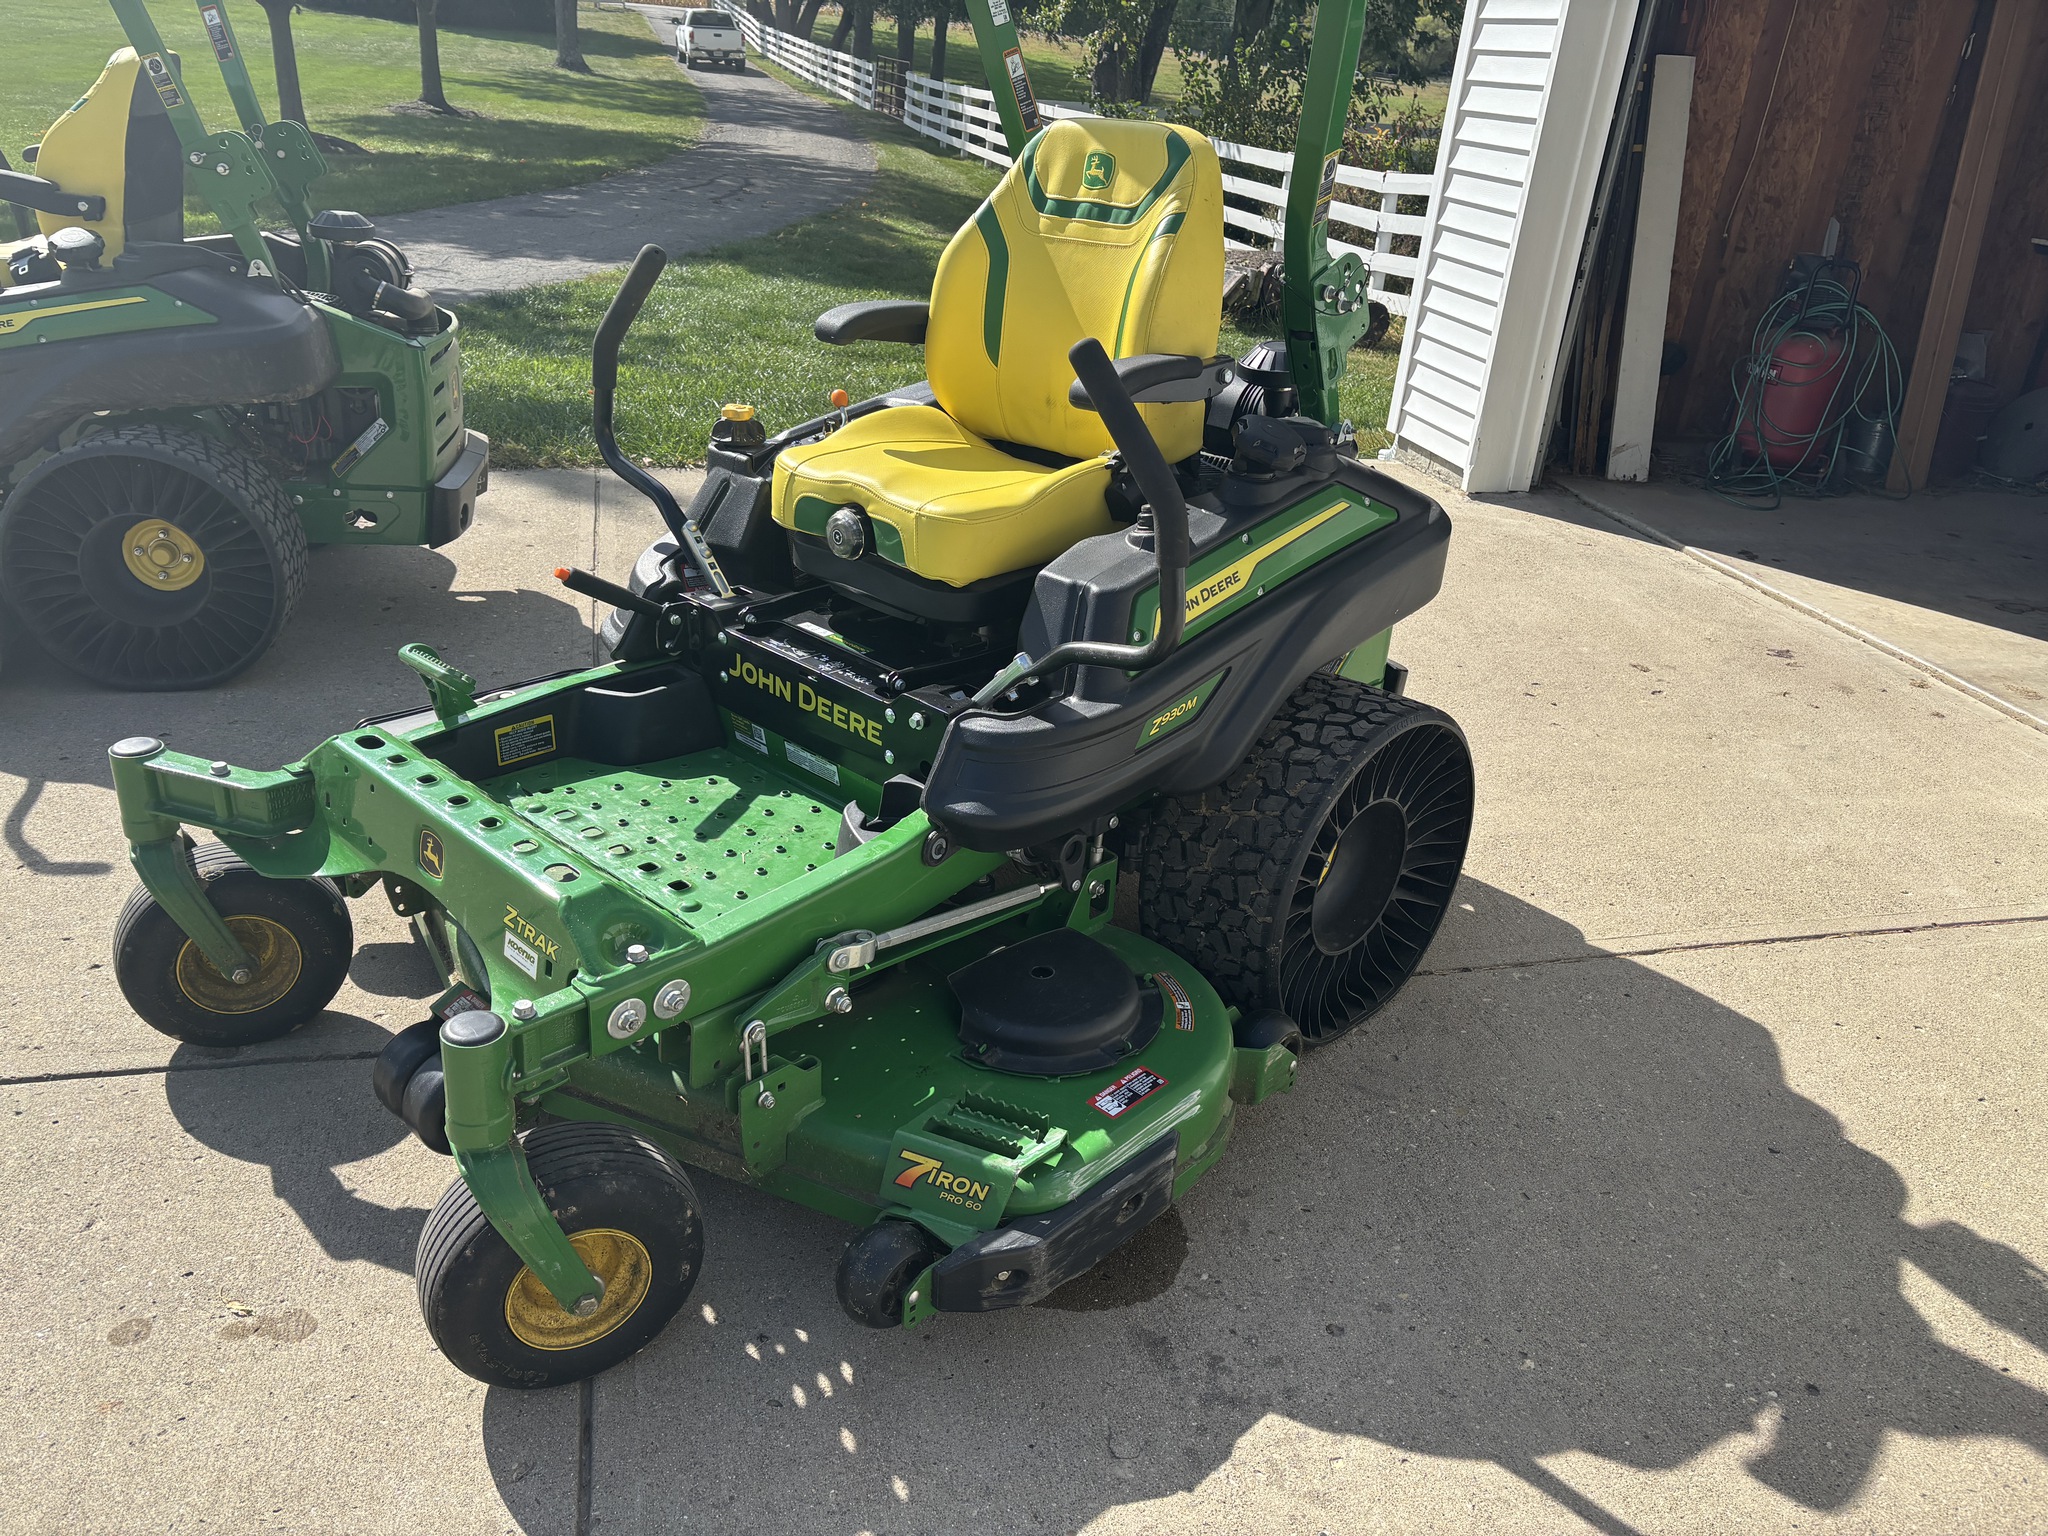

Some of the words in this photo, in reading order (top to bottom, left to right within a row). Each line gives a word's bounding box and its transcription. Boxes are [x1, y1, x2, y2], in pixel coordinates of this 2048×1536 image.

[0, 319, 15, 328] RE
[1200, 571, 1241, 603] DEERE
[729, 653, 791, 702] JOHN
[798, 682, 883, 746] DEERE
[1149, 695, 1198, 736] Z930M
[939, 1191, 963, 1206] PRO
[965, 1200, 982, 1211] 60
